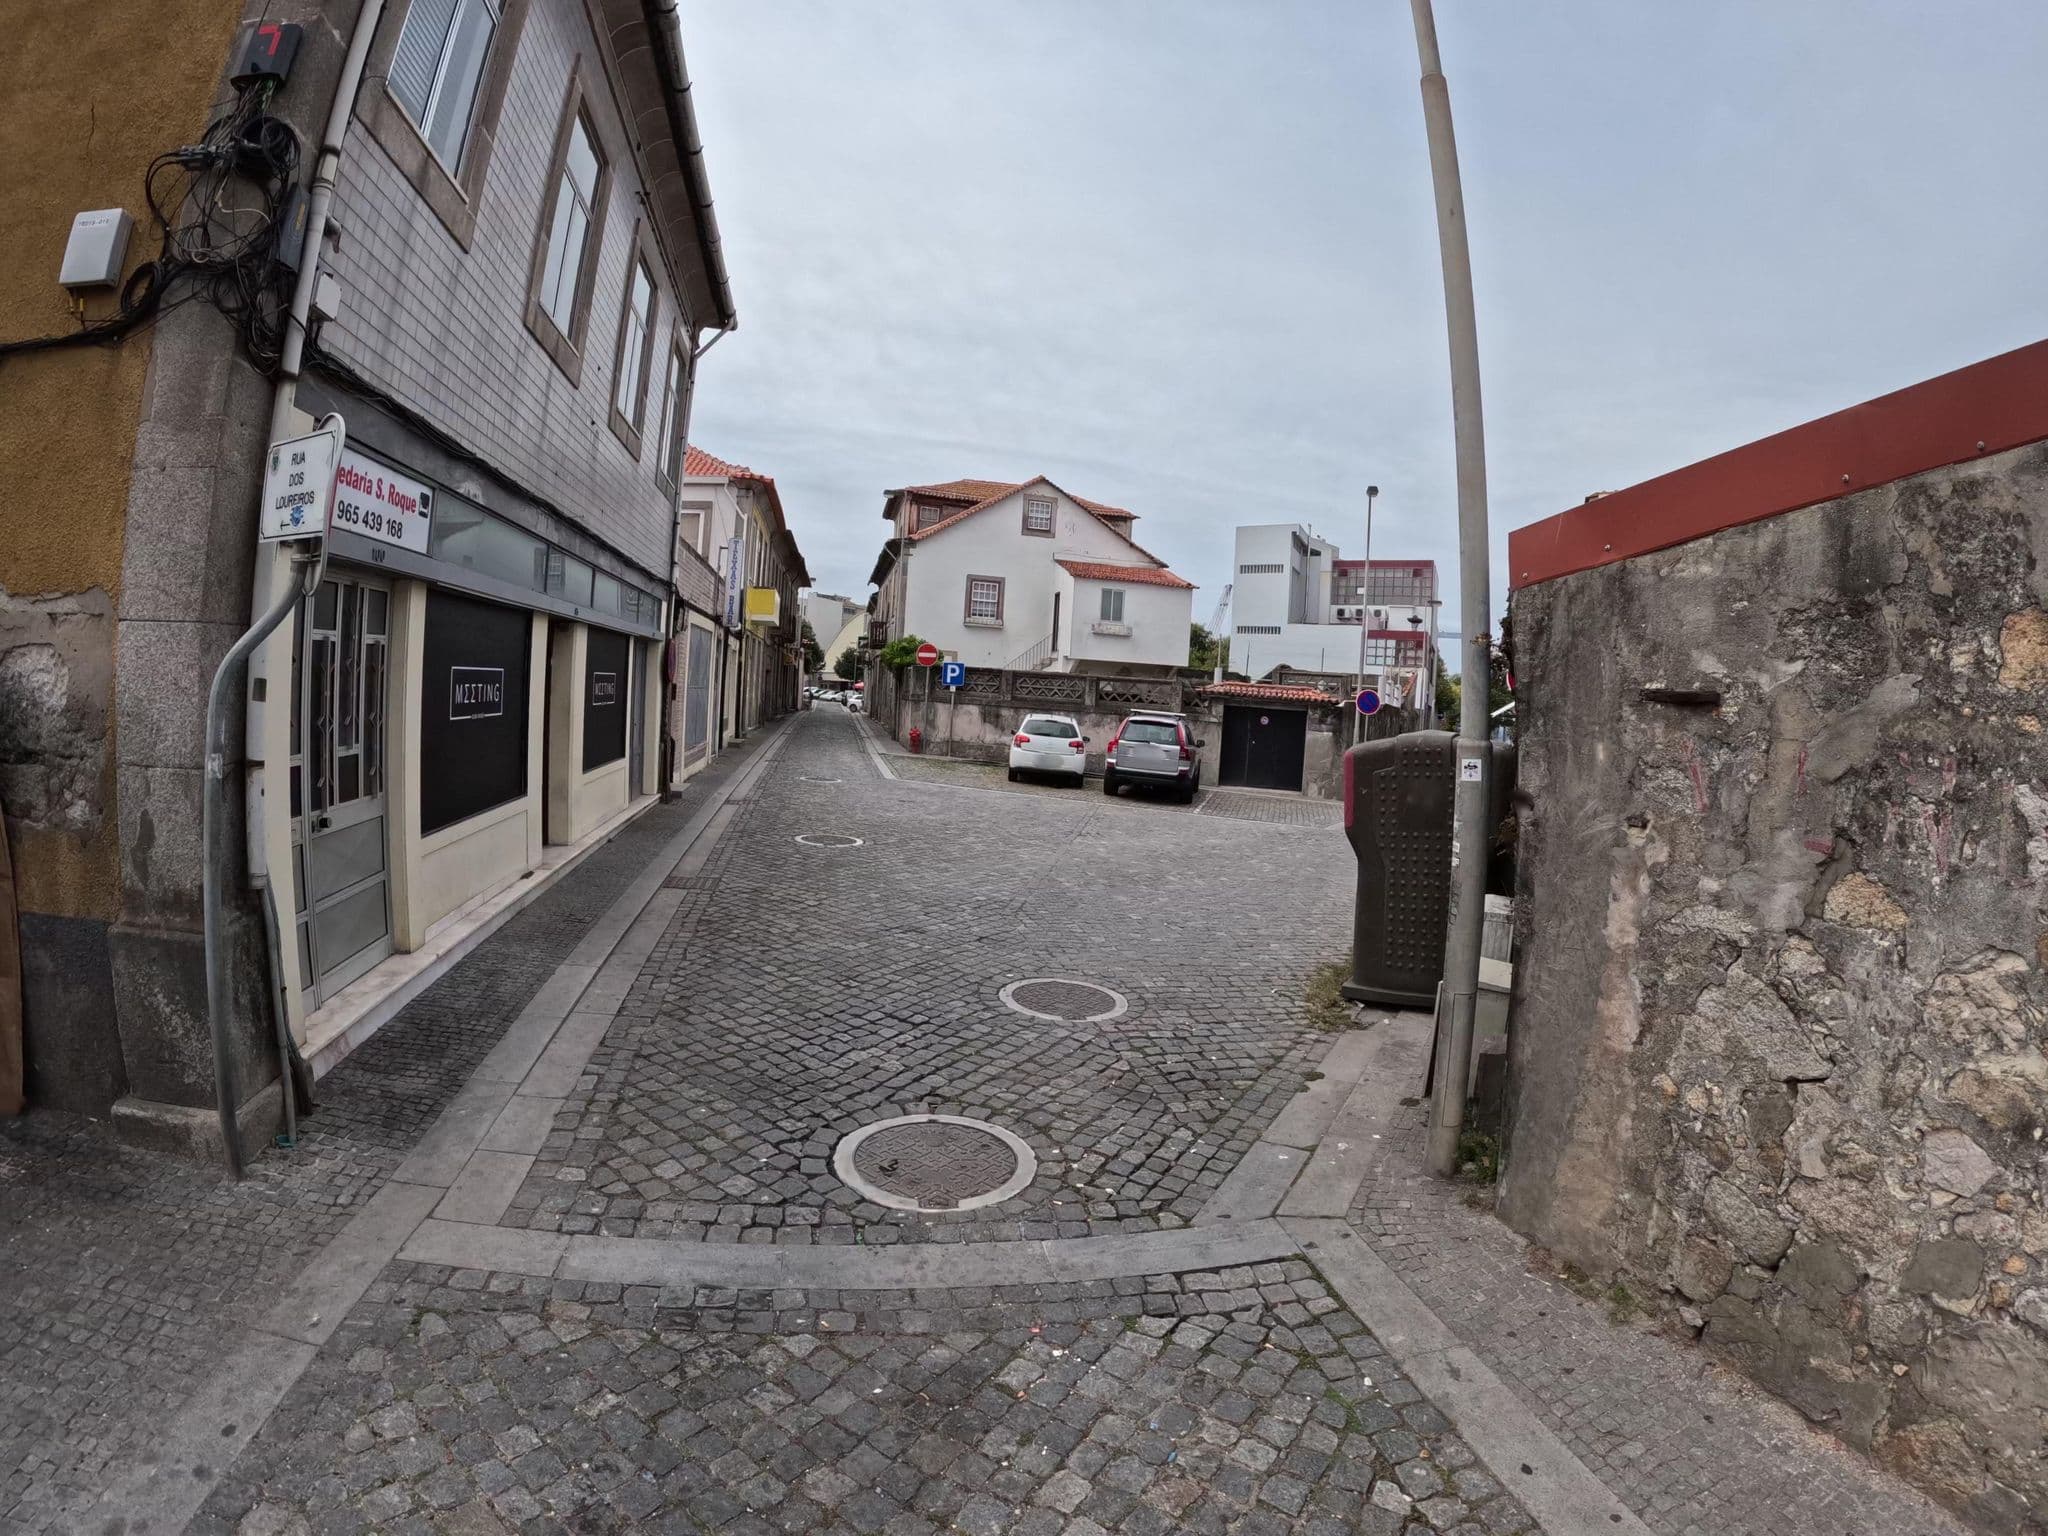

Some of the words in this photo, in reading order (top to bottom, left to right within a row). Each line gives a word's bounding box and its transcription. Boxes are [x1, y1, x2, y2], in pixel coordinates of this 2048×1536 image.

[291, 452, 306, 466] RUA
[288, 471, 305, 487] DOS
[275, 491, 315, 510] LOUREIROS
[375, 478, 385, 501] S.
[388, 482, 417, 515] Roque
[337, 499, 360, 525] 965
[362, 510, 383, 532] 439
[386, 517, 403, 539] 168
[946, 664, 960, 684] P
